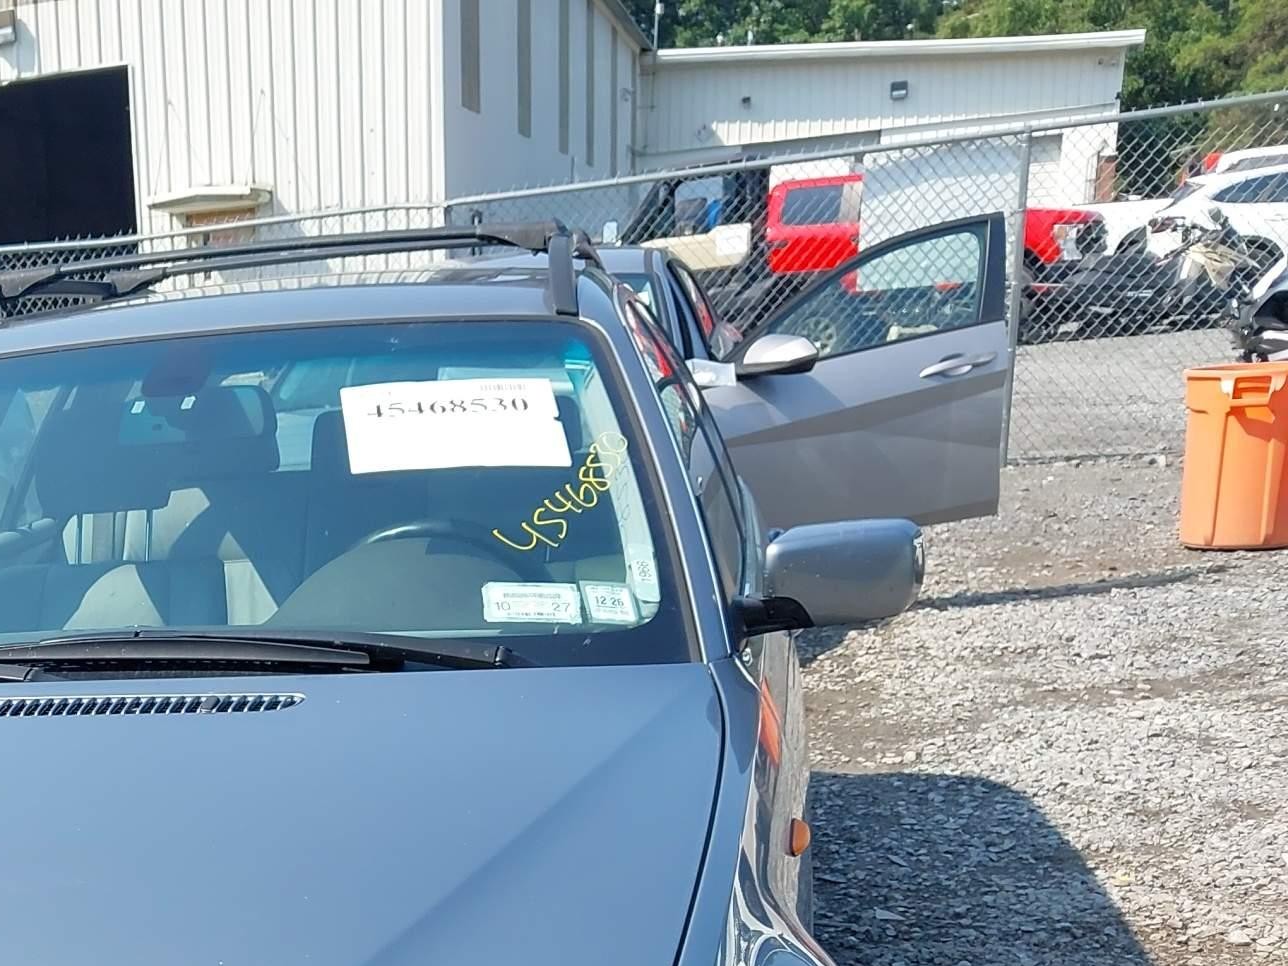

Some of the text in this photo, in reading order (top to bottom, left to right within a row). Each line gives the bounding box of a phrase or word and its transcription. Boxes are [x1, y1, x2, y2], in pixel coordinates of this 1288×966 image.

[368, 398, 529, 418] 45468530
[492, 431, 628, 550] 45468530
[496, 601, 571, 613] 10 27
